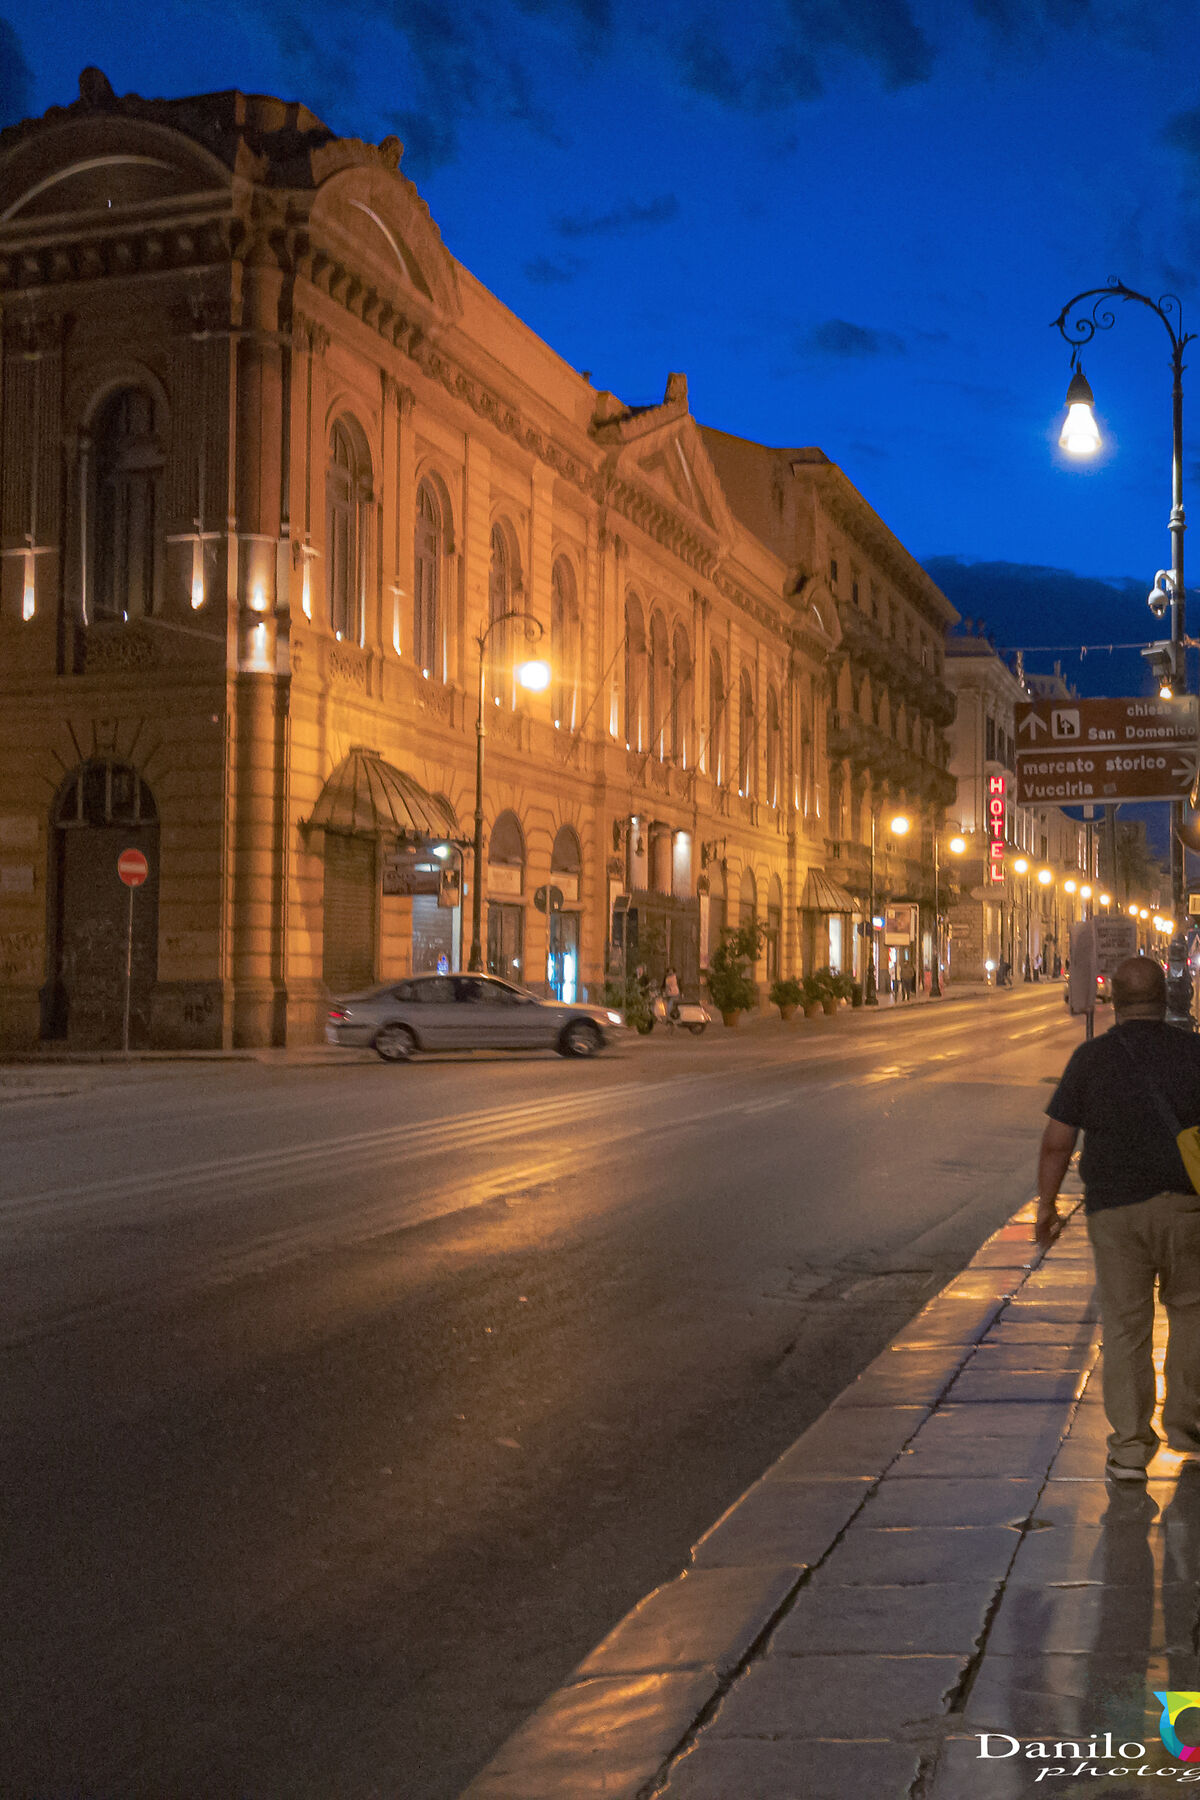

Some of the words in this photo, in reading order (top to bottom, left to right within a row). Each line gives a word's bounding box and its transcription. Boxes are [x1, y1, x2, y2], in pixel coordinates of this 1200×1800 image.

[1087, 727, 1116, 741] San
[1125, 724, 1196, 739] Domenico
[1023, 758, 1095, 775] mercato
[1105, 755, 1167, 772] storico
[1023, 780, 1094, 798] Vucciria
[990, 775, 1005, 882] HOTEL
